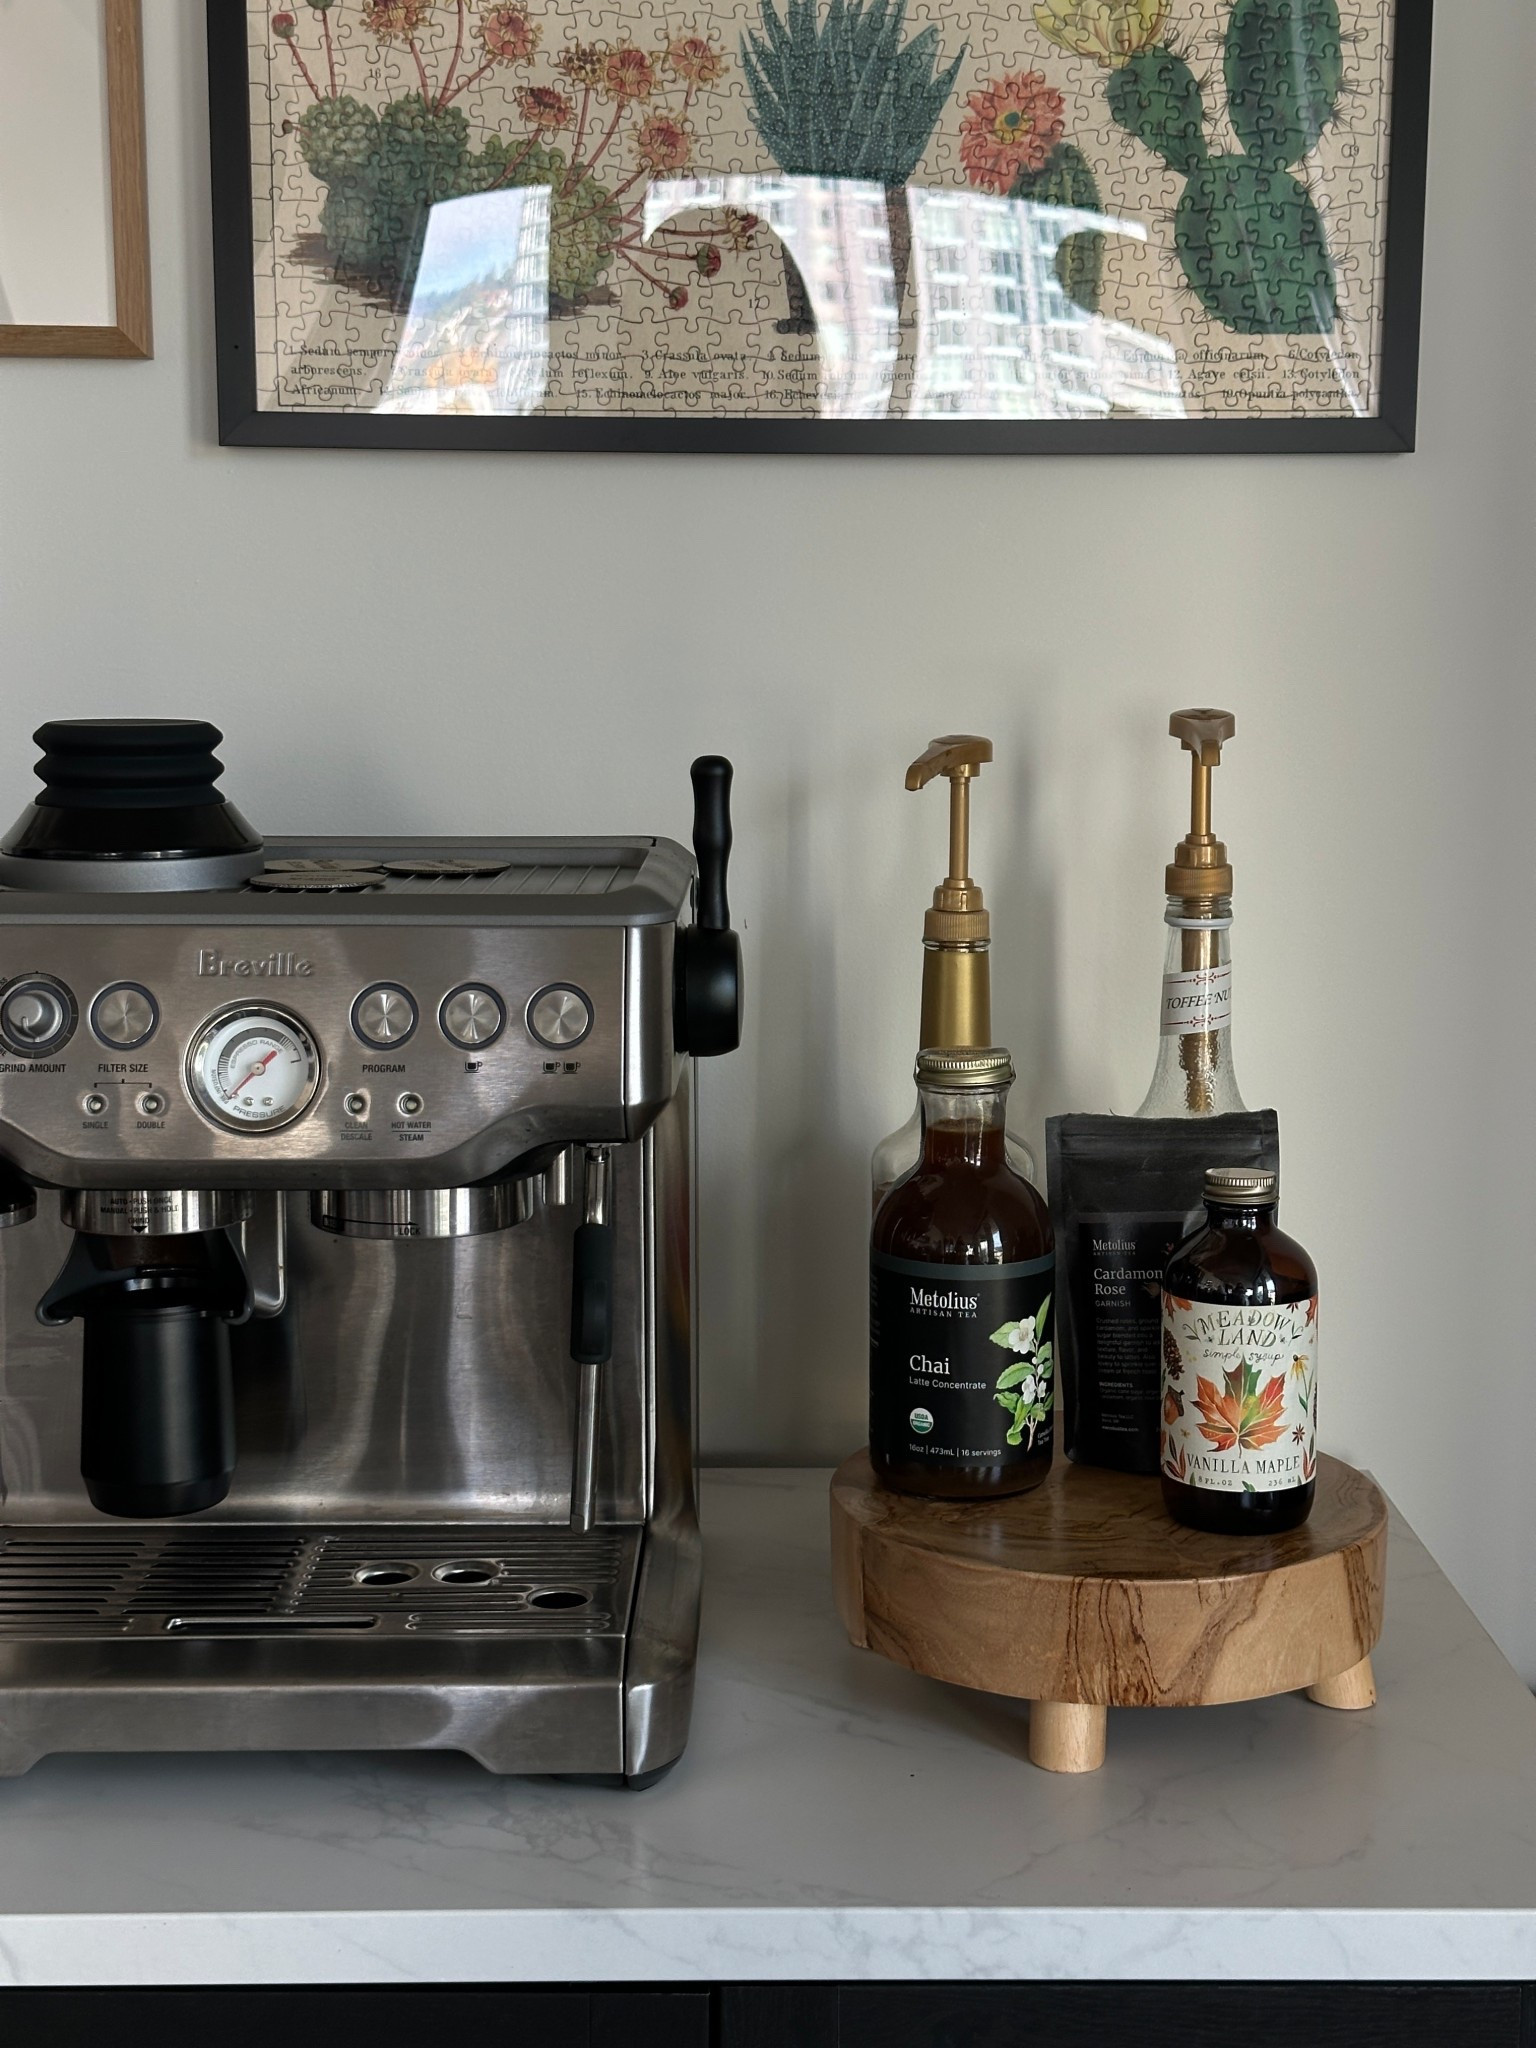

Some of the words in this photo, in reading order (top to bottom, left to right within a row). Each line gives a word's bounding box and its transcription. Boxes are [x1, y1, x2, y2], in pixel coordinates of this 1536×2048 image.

[369, 67, 382, 79] 16
[1188, 368, 1226, 382] Agave
[199, 948, 314, 977] Breville
[1166, 993, 1213, 1010] TOFFEE
[28, 1064, 67, 1073] AMOUNT
[97, 1063, 126, 1073] FILTER
[128, 1063, 149, 1073] SIZE
[362, 1064, 406, 1074] PROGRAM
[232, 1104, 287, 1119] PRESSURE
[82, 1121, 109, 1130] SINGLE
[136, 1121, 166, 1130] DOUBLE
[344, 1121, 368, 1130] CLEAN
[391, 1121, 405, 1130] HOT
[406, 1121, 432, 1130] WATER
[340, 1133, 373, 1142] DESCALE
[399, 1133, 425, 1142] STEAM
[398, 1226, 421, 1236] LOCK
[1092, 1238, 1136, 1251] Metolius
[1094, 1283, 1126, 1295] Rose
[909, 1286, 978, 1310] Metolius
[1095, 1299, 1131, 1308] GARNISH
[909, 1306, 952, 1318] ARTISAN
[957, 1310, 978, 1319] TEA
[1197, 1308, 1291, 1335] MEADOW
[1217, 1327, 1277, 1348] LAND
[909, 1354, 951, 1375] Chai
[909, 1376, 930, 1387] Latte
[932, 1379, 987, 1390] Concentrate
[909, 1443, 925, 1453] 16oz
[929, 1447, 955, 1457] 473mL
[961, 1449, 970, 1457] 16
[971, 1448, 1002, 1458] servings
[1186, 1453, 1251, 1475] VANILLA
[1256, 1455, 1300, 1475] MAPLE
[1268, 1479, 1283, 1487] 236
